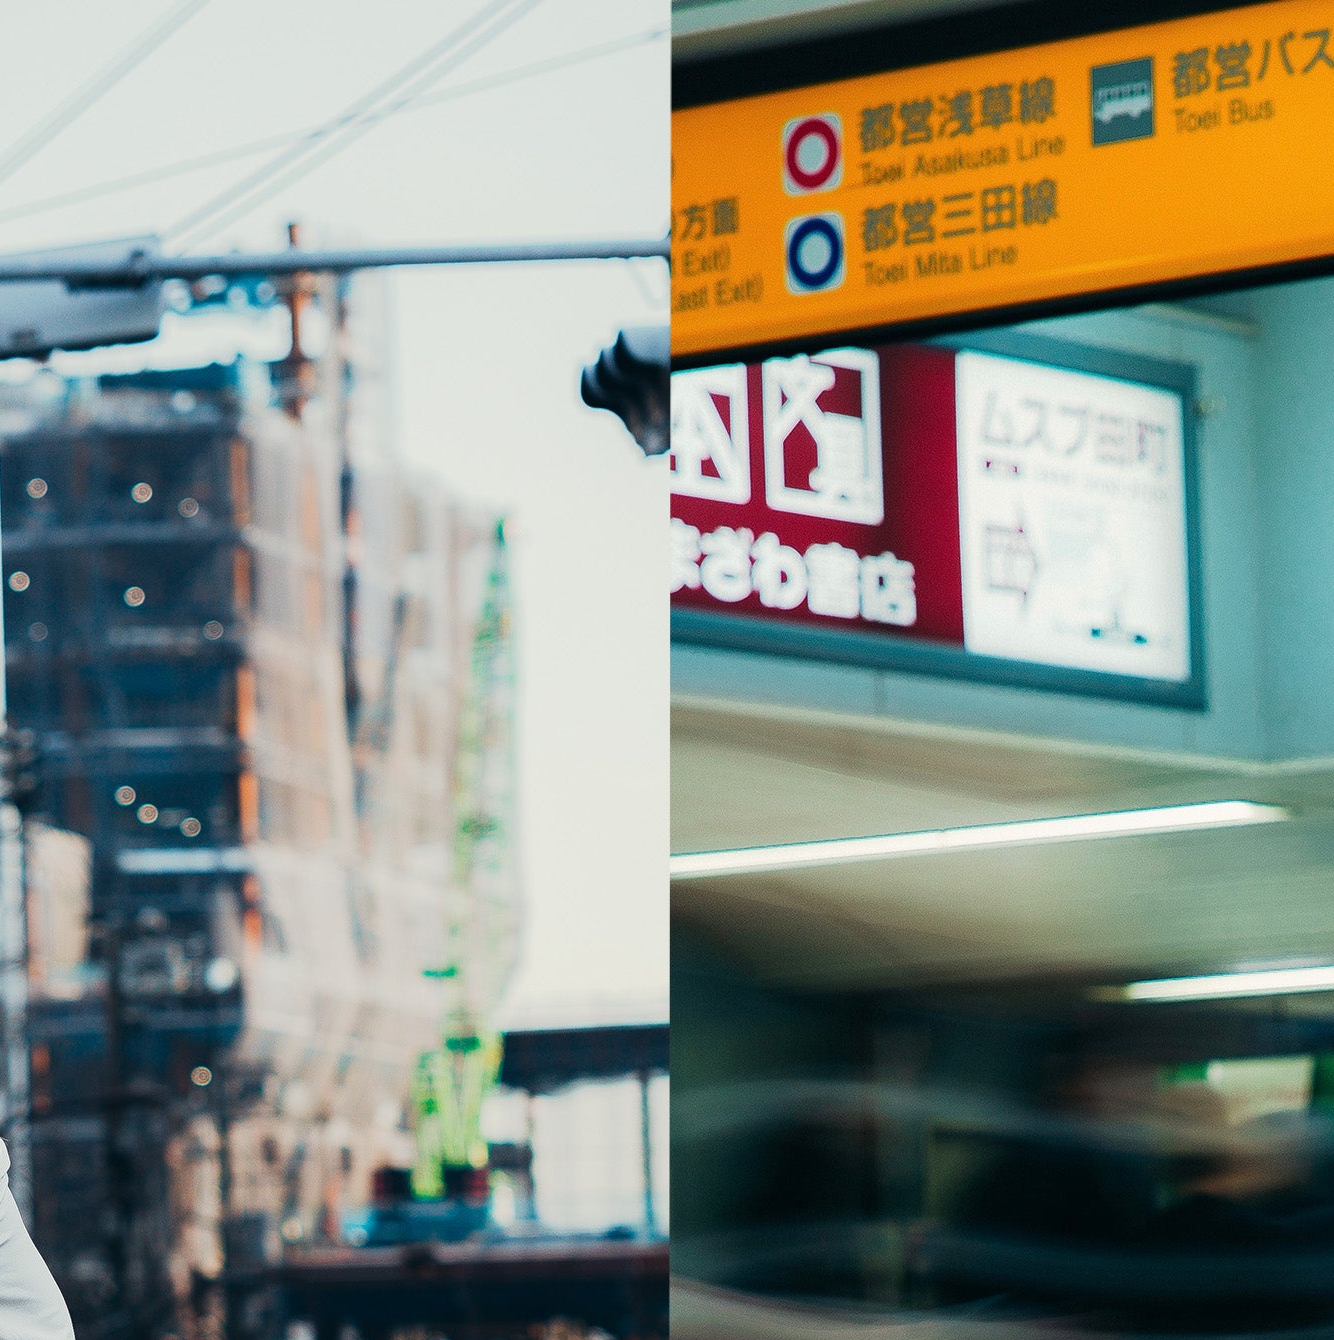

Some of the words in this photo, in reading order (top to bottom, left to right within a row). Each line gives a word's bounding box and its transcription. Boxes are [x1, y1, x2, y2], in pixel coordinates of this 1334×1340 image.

[861, 75, 1056, 152] 都営浅草線
[1174, 108, 1221, 133] Toei
[1228, 99, 1275, 126] Bus
[861, 159, 905, 186] Toei
[914, 146, 1010, 177] Asakusa
[1016, 136, 1065, 161] Line
[863, 178, 1059, 252] 都営三田線
[863, 257, 908, 285] Toei
[915, 252, 962, 278] Mita
[969, 244, 1018, 271] Line
